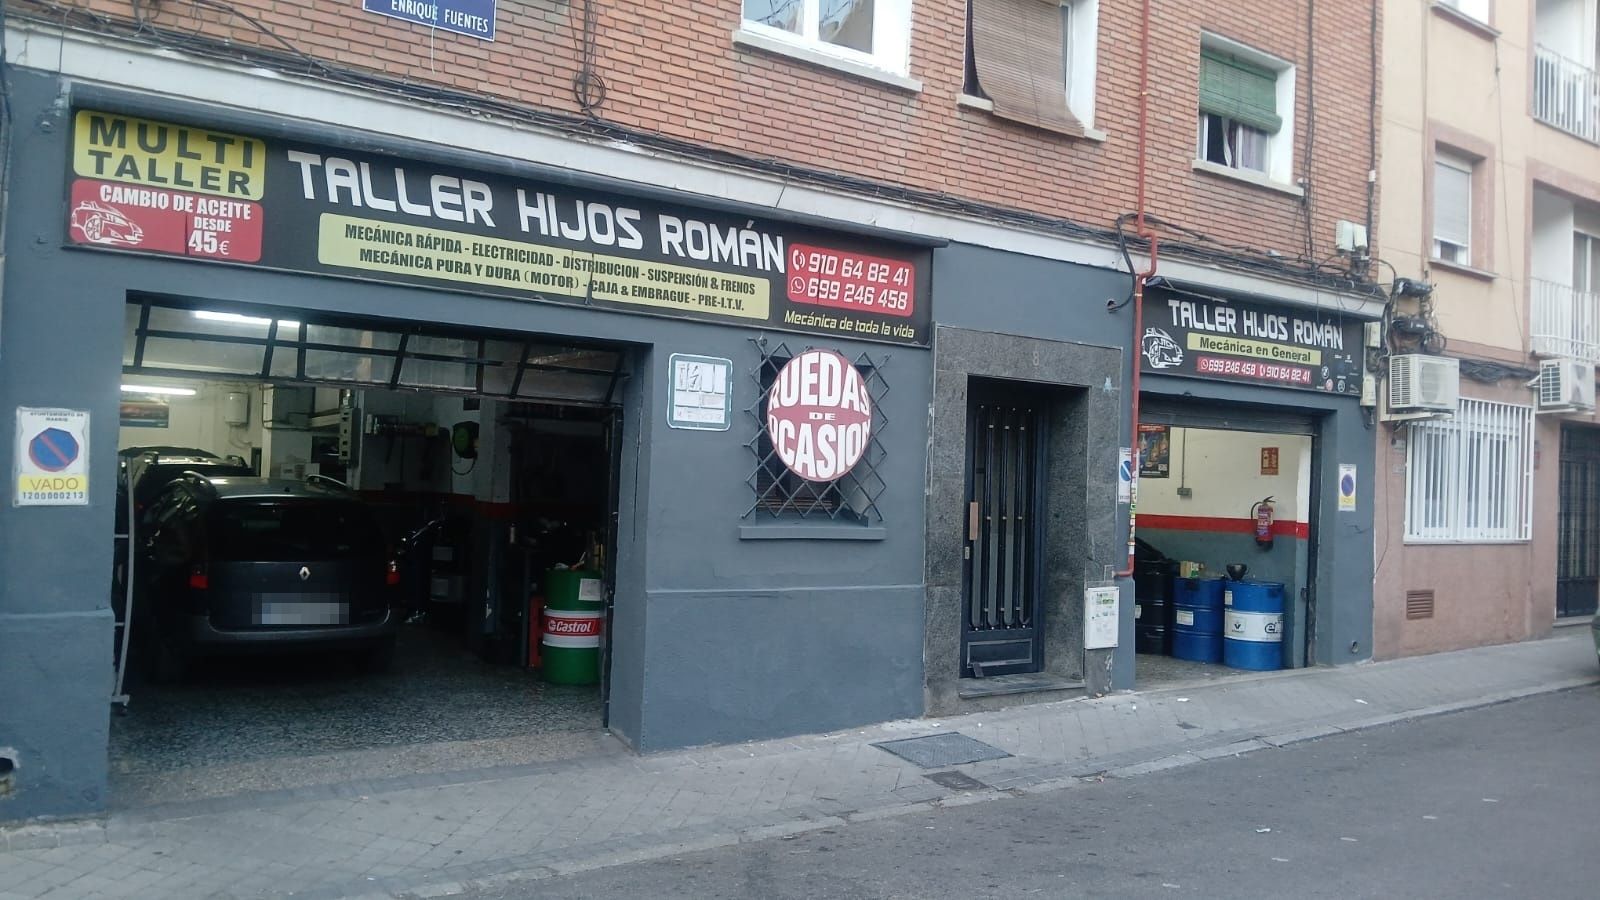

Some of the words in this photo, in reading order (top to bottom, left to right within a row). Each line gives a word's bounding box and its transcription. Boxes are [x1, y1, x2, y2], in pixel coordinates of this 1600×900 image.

[391, 0, 438, 21] ENRIQUE
[444, 9, 489, 33] FUENTES
[89, 115, 253, 168] MULTI
[88, 149, 251, 196] TALLER
[99, 184, 170, 210] CAMBIO
[173, 194, 194, 213] DE
[196, 198, 251, 220] ACEITE
[287, 150, 497, 228] TALLER
[516, 189, 644, 250] HIJOS
[658, 214, 785, 273] ROMÁN
[193, 216, 232, 233] DESDE
[188, 231, 230, 255] 45€
[345, 223, 413, 247] MECÁNICA
[416, 232, 462, 254] RÁPIDA
[472, 242, 554, 267] ELECTRICIDAD
[562, 255, 640, 278] DISTRIBUCION
[647, 267, 709, 288] SUSPENSIÓN
[710, 277, 719, 290] &
[721, 279, 756, 295] FRENOS
[359, 247, 433, 271] MECÁNICA
[436, 258, 471, 275] PURA
[474, 263, 483, 277] Y
[485, 265, 521, 282] DURA
[591, 279, 618, 294] CAJA
[620, 284, 629, 296] &
[631, 285, 690, 304] EMBRAGUE
[698, 296, 745, 311] PRE-I.T.V.
[808, 252, 839, 275] 910
[841, 258, 863, 280] 64
[867, 262, 890, 284] 82
[893, 267, 910, 287] 41
[807, 278, 841, 300] 699
[843, 283, 875, 306] 246
[878, 289, 908, 310] 458
[784, 309, 837, 329] Mecánica
[839, 316, 853, 331] de
[855, 319, 880, 334] toda
[881, 321, 891, 336] la
[893, 323, 915, 339] vida
[1167, 299, 1238, 334] TALLER
[1242, 308, 1289, 341] HIJOS
[1293, 318, 1344, 350] ROMÁN
[1033, 351, 1040, 366] 8
[1199, 336, 1253, 354] Mecánica
[1255, 346, 1268, 356] en
[1271, 346, 1311, 363] General
[769, 351, 870, 417] RUEDAS
[1208, 359, 1224, 373] 699
[1224, 361, 1241, 374] 246
[1241, 362, 1256, 376] 458
[1265, 365, 1279, 378] 910
[1279, 367, 1290, 380] 64
[1290, 368, 1301, 381] 82
[1302, 369, 1311, 383] 41
[809, 412, 836, 421] DE
[23, 491, 84, 500] 1200000213
[30, 477, 80, 491] VADO
[556, 621, 592, 633] Castrol
